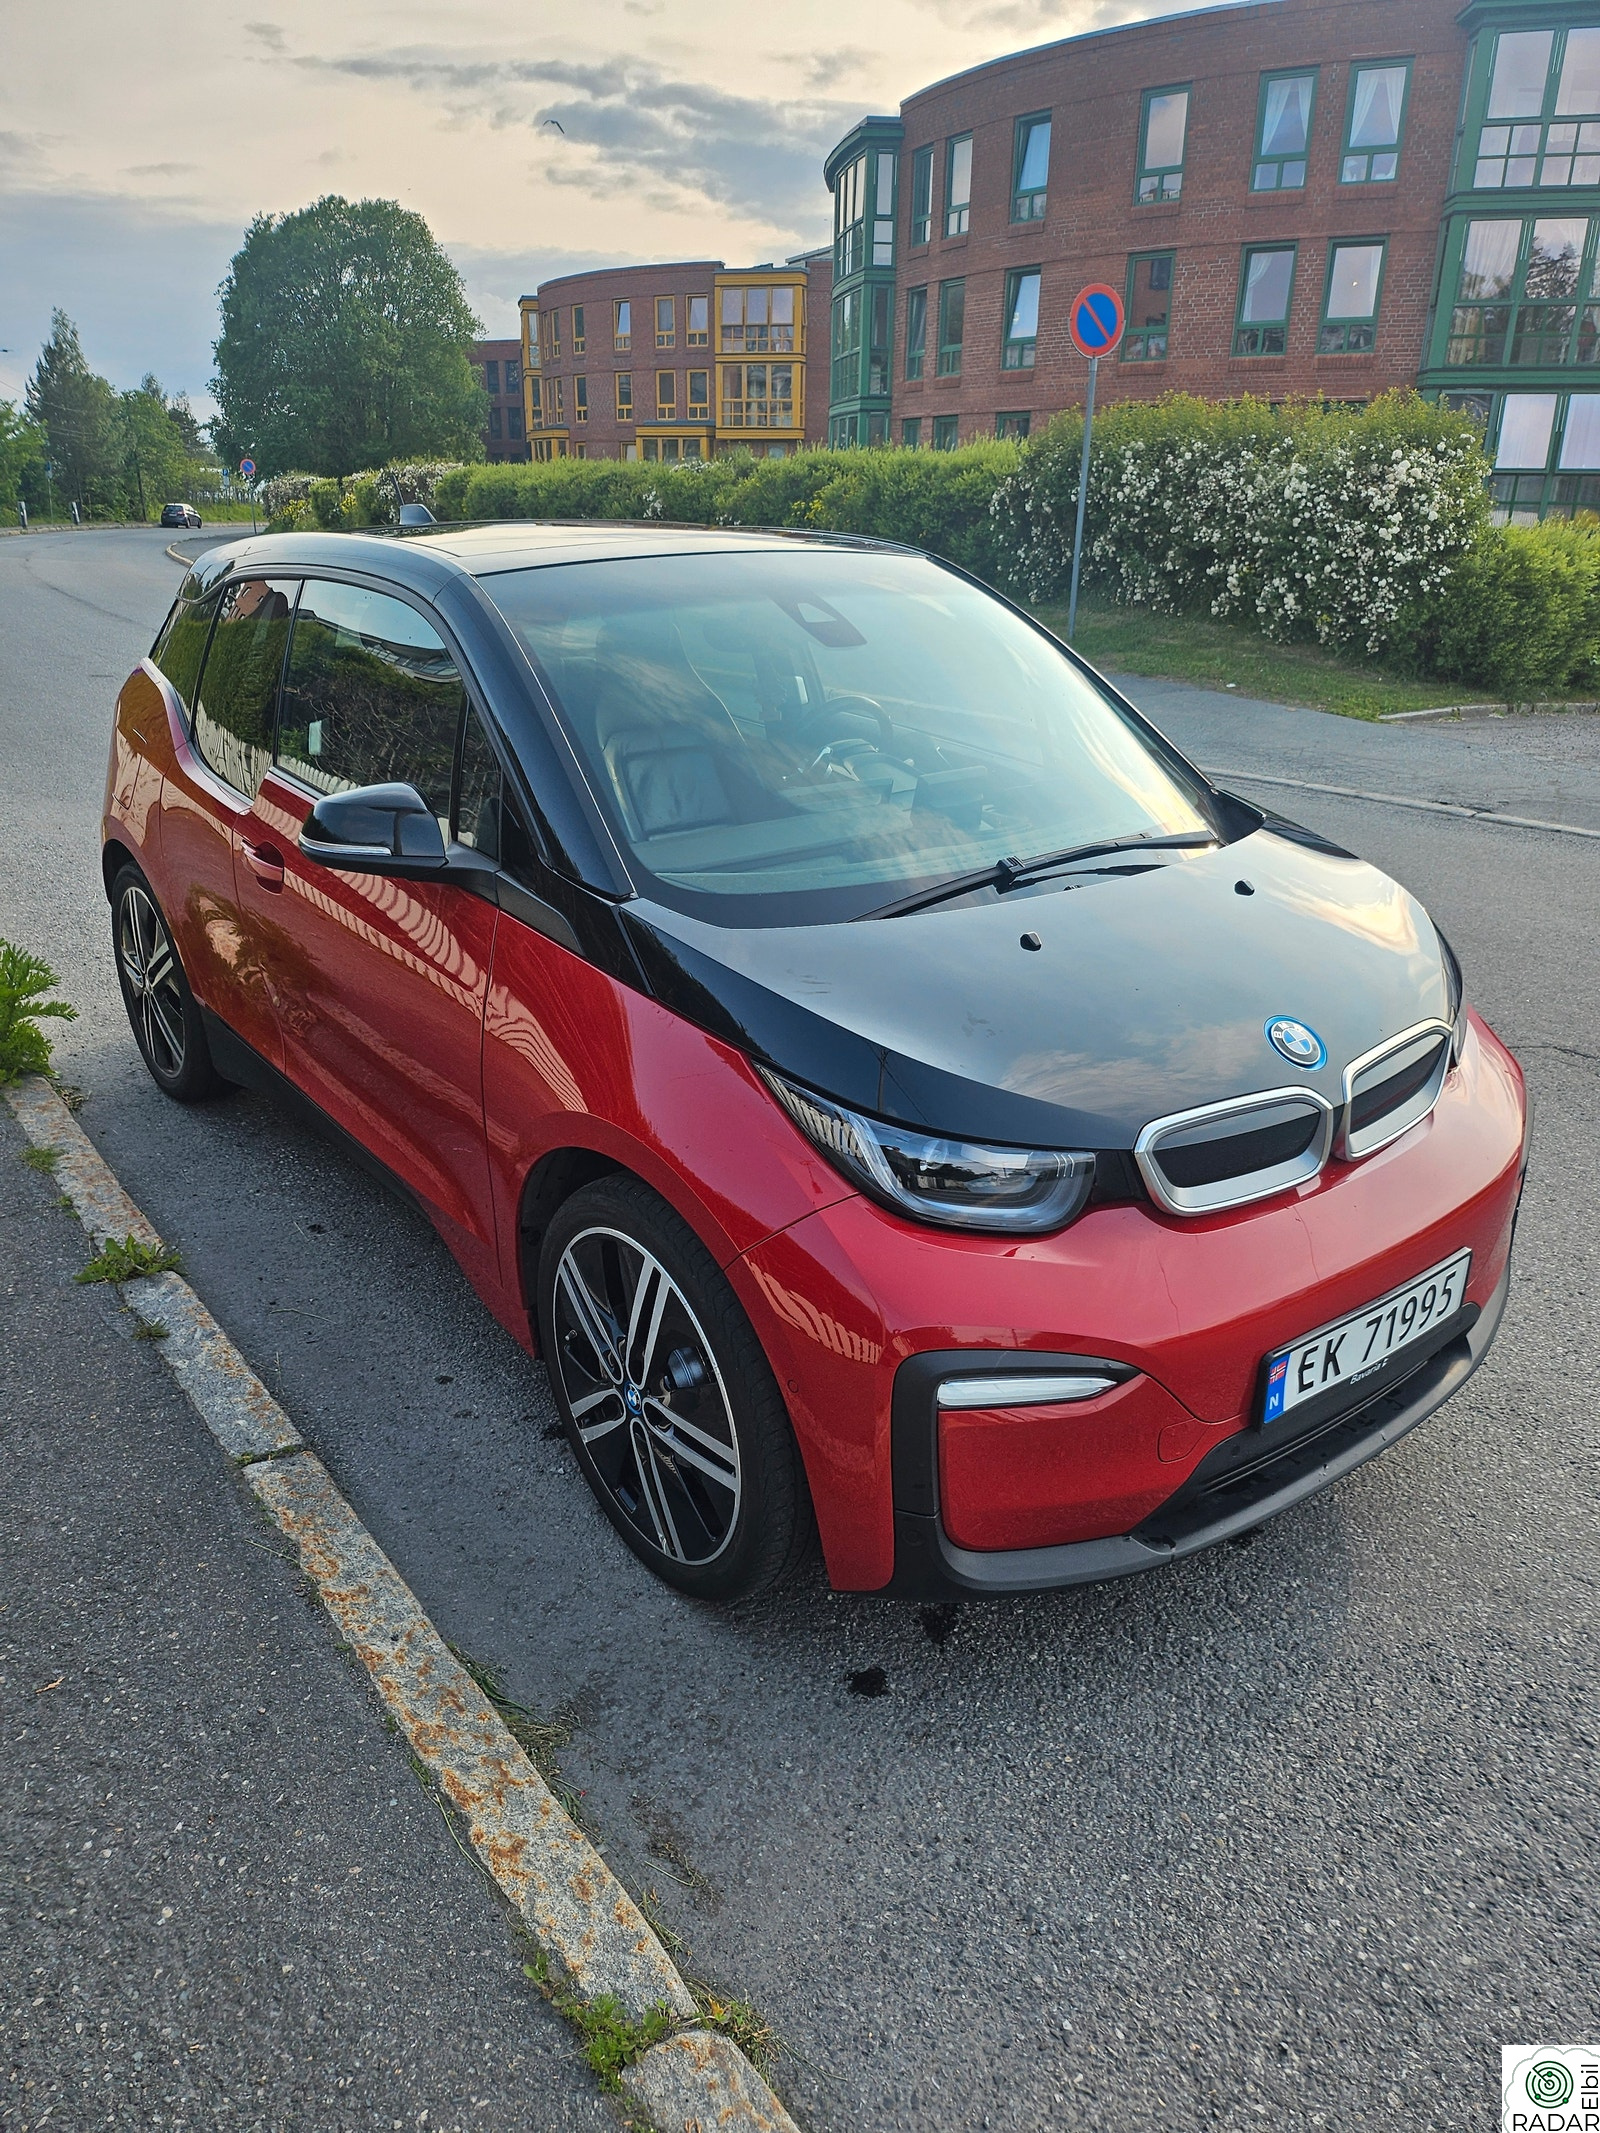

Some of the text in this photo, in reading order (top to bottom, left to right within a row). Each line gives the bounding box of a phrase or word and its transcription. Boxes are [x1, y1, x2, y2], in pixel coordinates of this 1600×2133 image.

[1298, 1270, 1457, 1394] EK 71995
[1268, 1394, 1279, 1410] N
